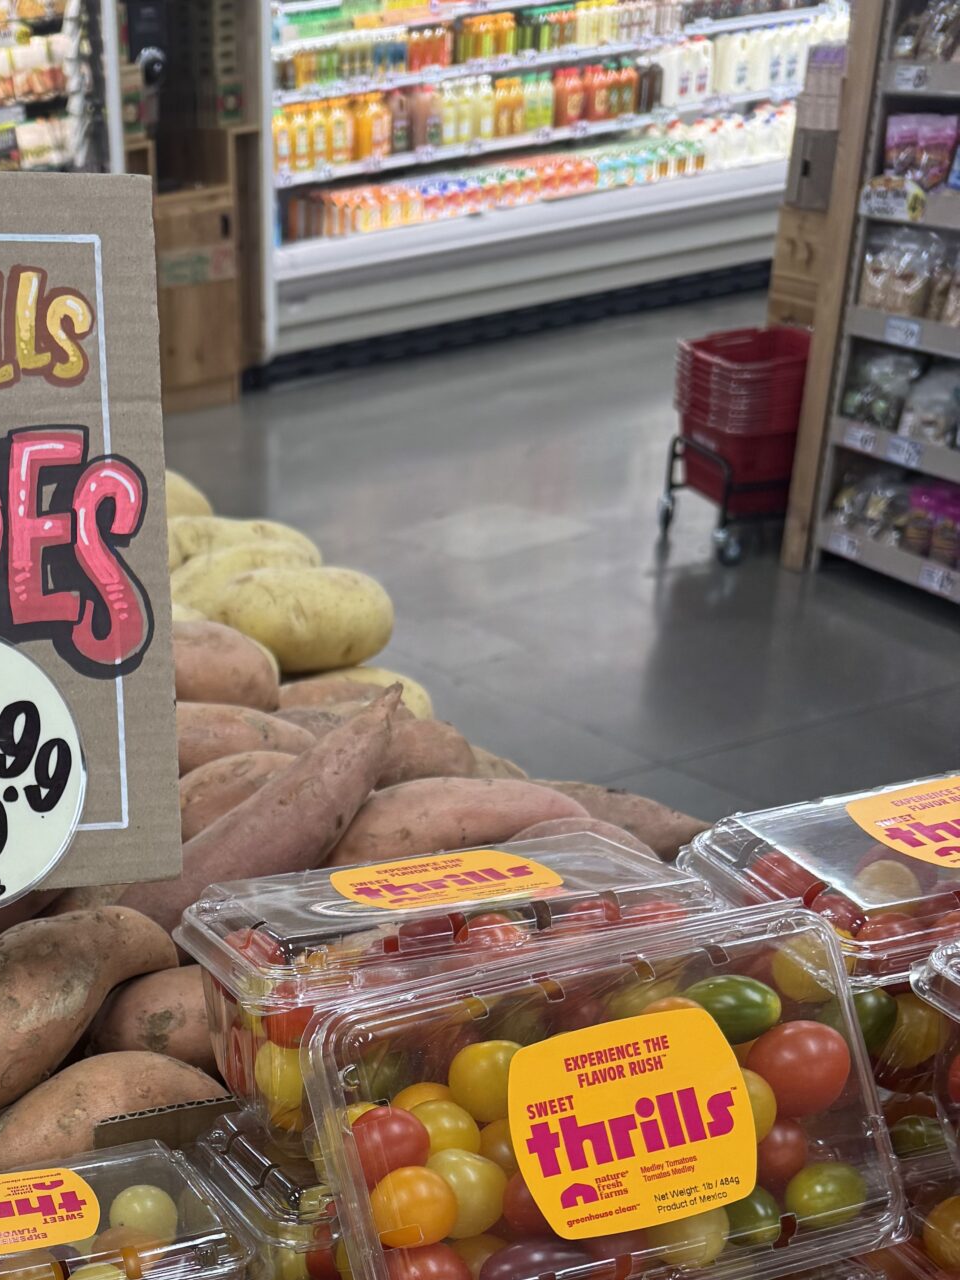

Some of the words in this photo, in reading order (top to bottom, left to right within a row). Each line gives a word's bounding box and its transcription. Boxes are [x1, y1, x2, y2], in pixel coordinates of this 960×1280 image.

[563, 1041, 642, 1073] EXPERIENCE
[642, 1034, 670, 1054] THE
[577, 1064, 626, 1089] FLAVOR
[526, 1094, 574, 1120] SWEET
[639, 1163, 664, 1174] Medley
[664, 1155, 698, 1168] Tomatoes
[670, 1164, 695, 1176] Medley
[596, 1177, 624, 1193] fresh
[599, 1185, 629, 1201] farms
[653, 1192, 669, 1202] Net
[656, 1199, 689, 1214] Product
[698, 1191, 728, 1204] Mexico
[566, 1210, 614, 1228] greenhouse
